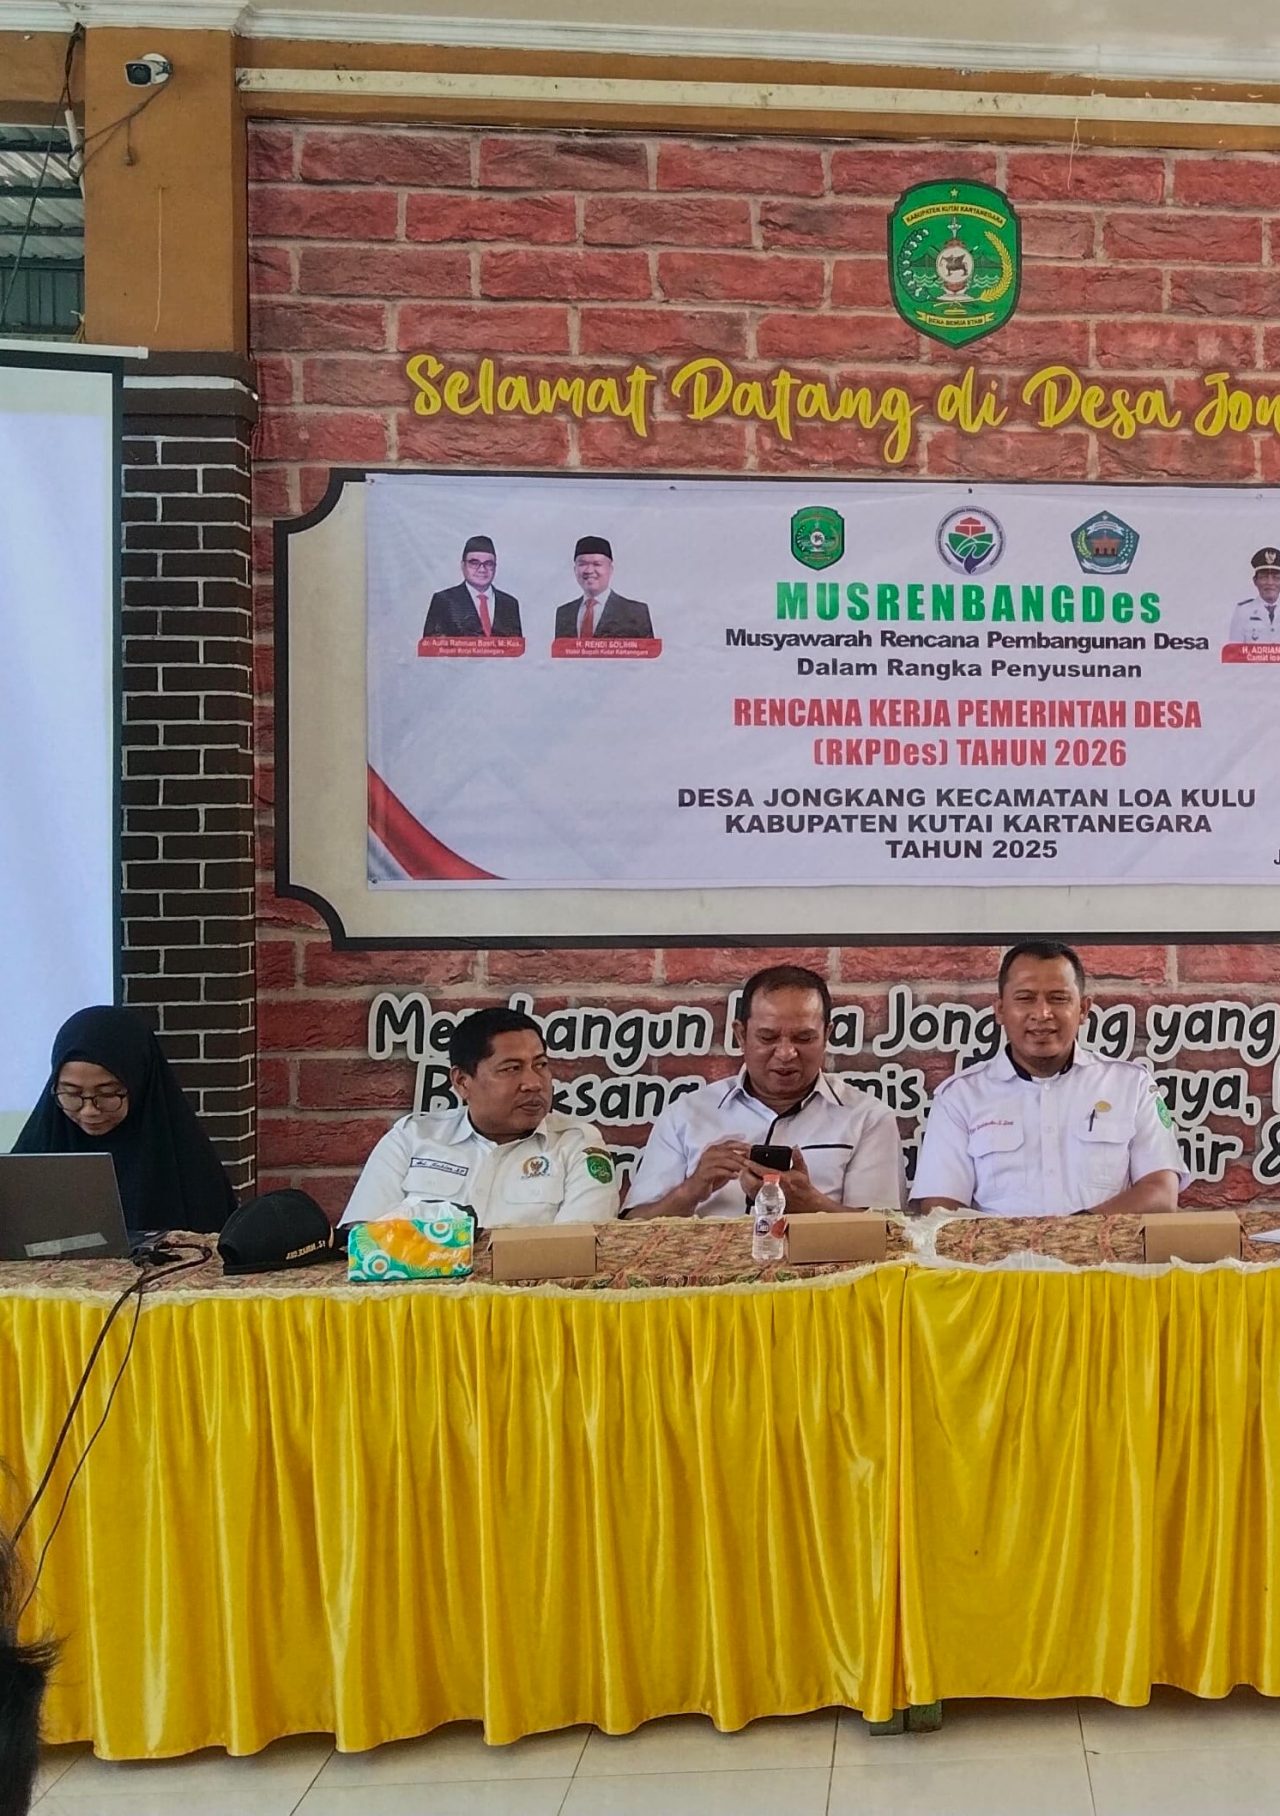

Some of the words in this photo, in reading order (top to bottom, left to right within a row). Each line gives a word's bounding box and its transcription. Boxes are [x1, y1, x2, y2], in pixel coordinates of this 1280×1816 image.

[406, 354, 656, 437] Selamat
[671, 357, 922, 463] Datang
[937, 366, 1008, 432] di
[1023, 366, 1182, 439] Desa
[776, 581, 1161, 624] MUSRENBANGDes
[726, 629, 872, 651] Musyawarah
[881, 629, 980, 649] Rencana
[988, 630, 1146, 653] Pembangunan
[1154, 632, 1209, 650] Desa
[797, 657, 878, 676] Dalam
[887, 658, 982, 681] Rangka
[992, 659, 1142, 682] Penyusunan
[734, 698, 861, 726] RENCANA
[868, 699, 951, 727] KERJA
[957, 699, 1127, 728] PEMERINTAH
[1134, 700, 1201, 728] DESA
[813, 738, 949, 766] (RKPDes)
[957, 739, 1047, 766] TAHUN
[1055, 739, 1126, 767] 2026
[678, 788, 754, 808] DESA
[763, 788, 926, 808] JONGKANG
[936, 788, 1107, 808] KECAMATAN
[1118, 788, 1172, 808] LOA
[1181, 789, 1255, 808] KULU
[725, 814, 896, 834] KABUPATEN
[908, 814, 993, 834] KUTAI
[1003, 814, 1212, 833] KARTANEGARA
[885, 839, 983, 859] TAHUN
[993, 839, 1058, 859] 2025
[375, 998, 706, 1067] Meangun
[879, 992, 1129, 1060] Jongng
[1153, 1007, 1276, 1060] yang
